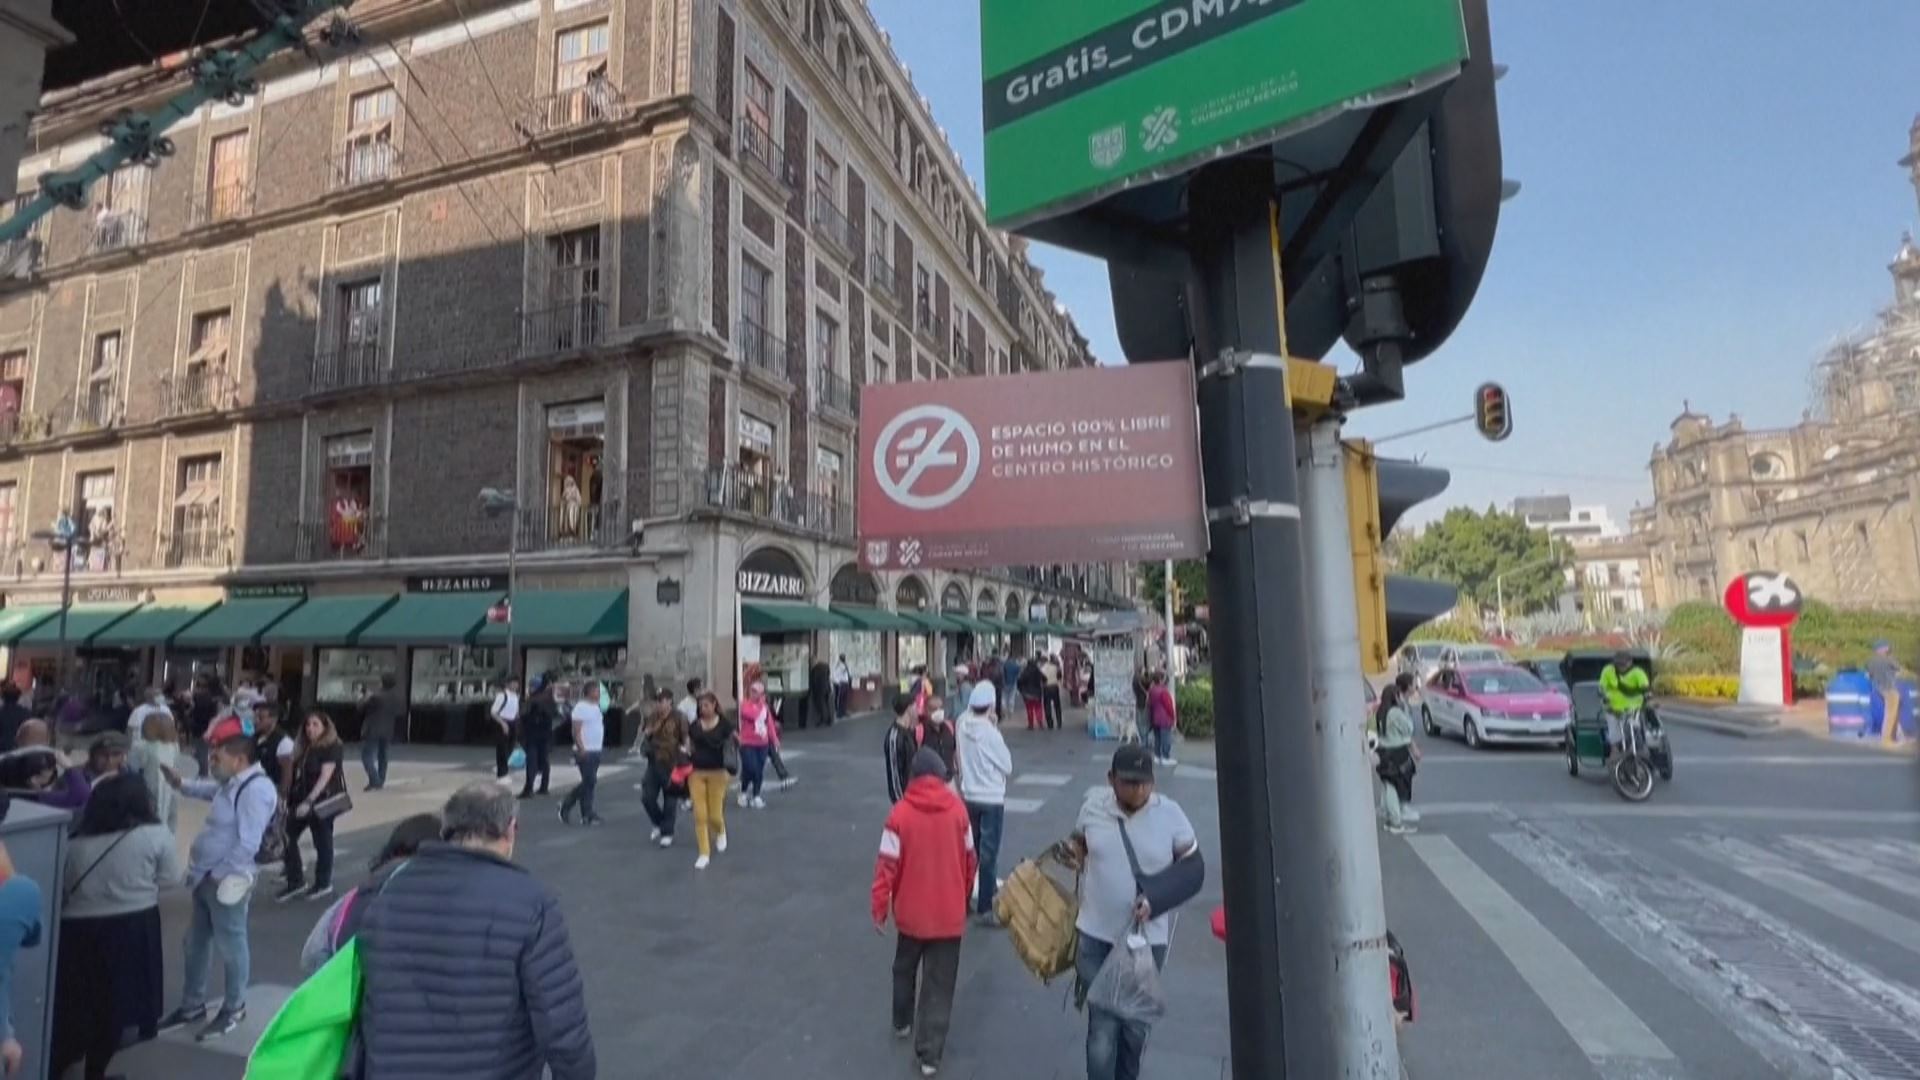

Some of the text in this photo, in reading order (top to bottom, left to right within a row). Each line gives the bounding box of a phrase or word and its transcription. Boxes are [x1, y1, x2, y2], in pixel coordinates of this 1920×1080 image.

[991, 415, 1171, 440] ESPACIO 100% LIBRE
[991, 437, 1129, 459] DE HUMO EN EL
[991, 454, 1173, 478] CENTRO HISTÓRICO
[422, 577, 491, 591] BIZZARRO
[738, 570, 805, 597] BIZZARRO
